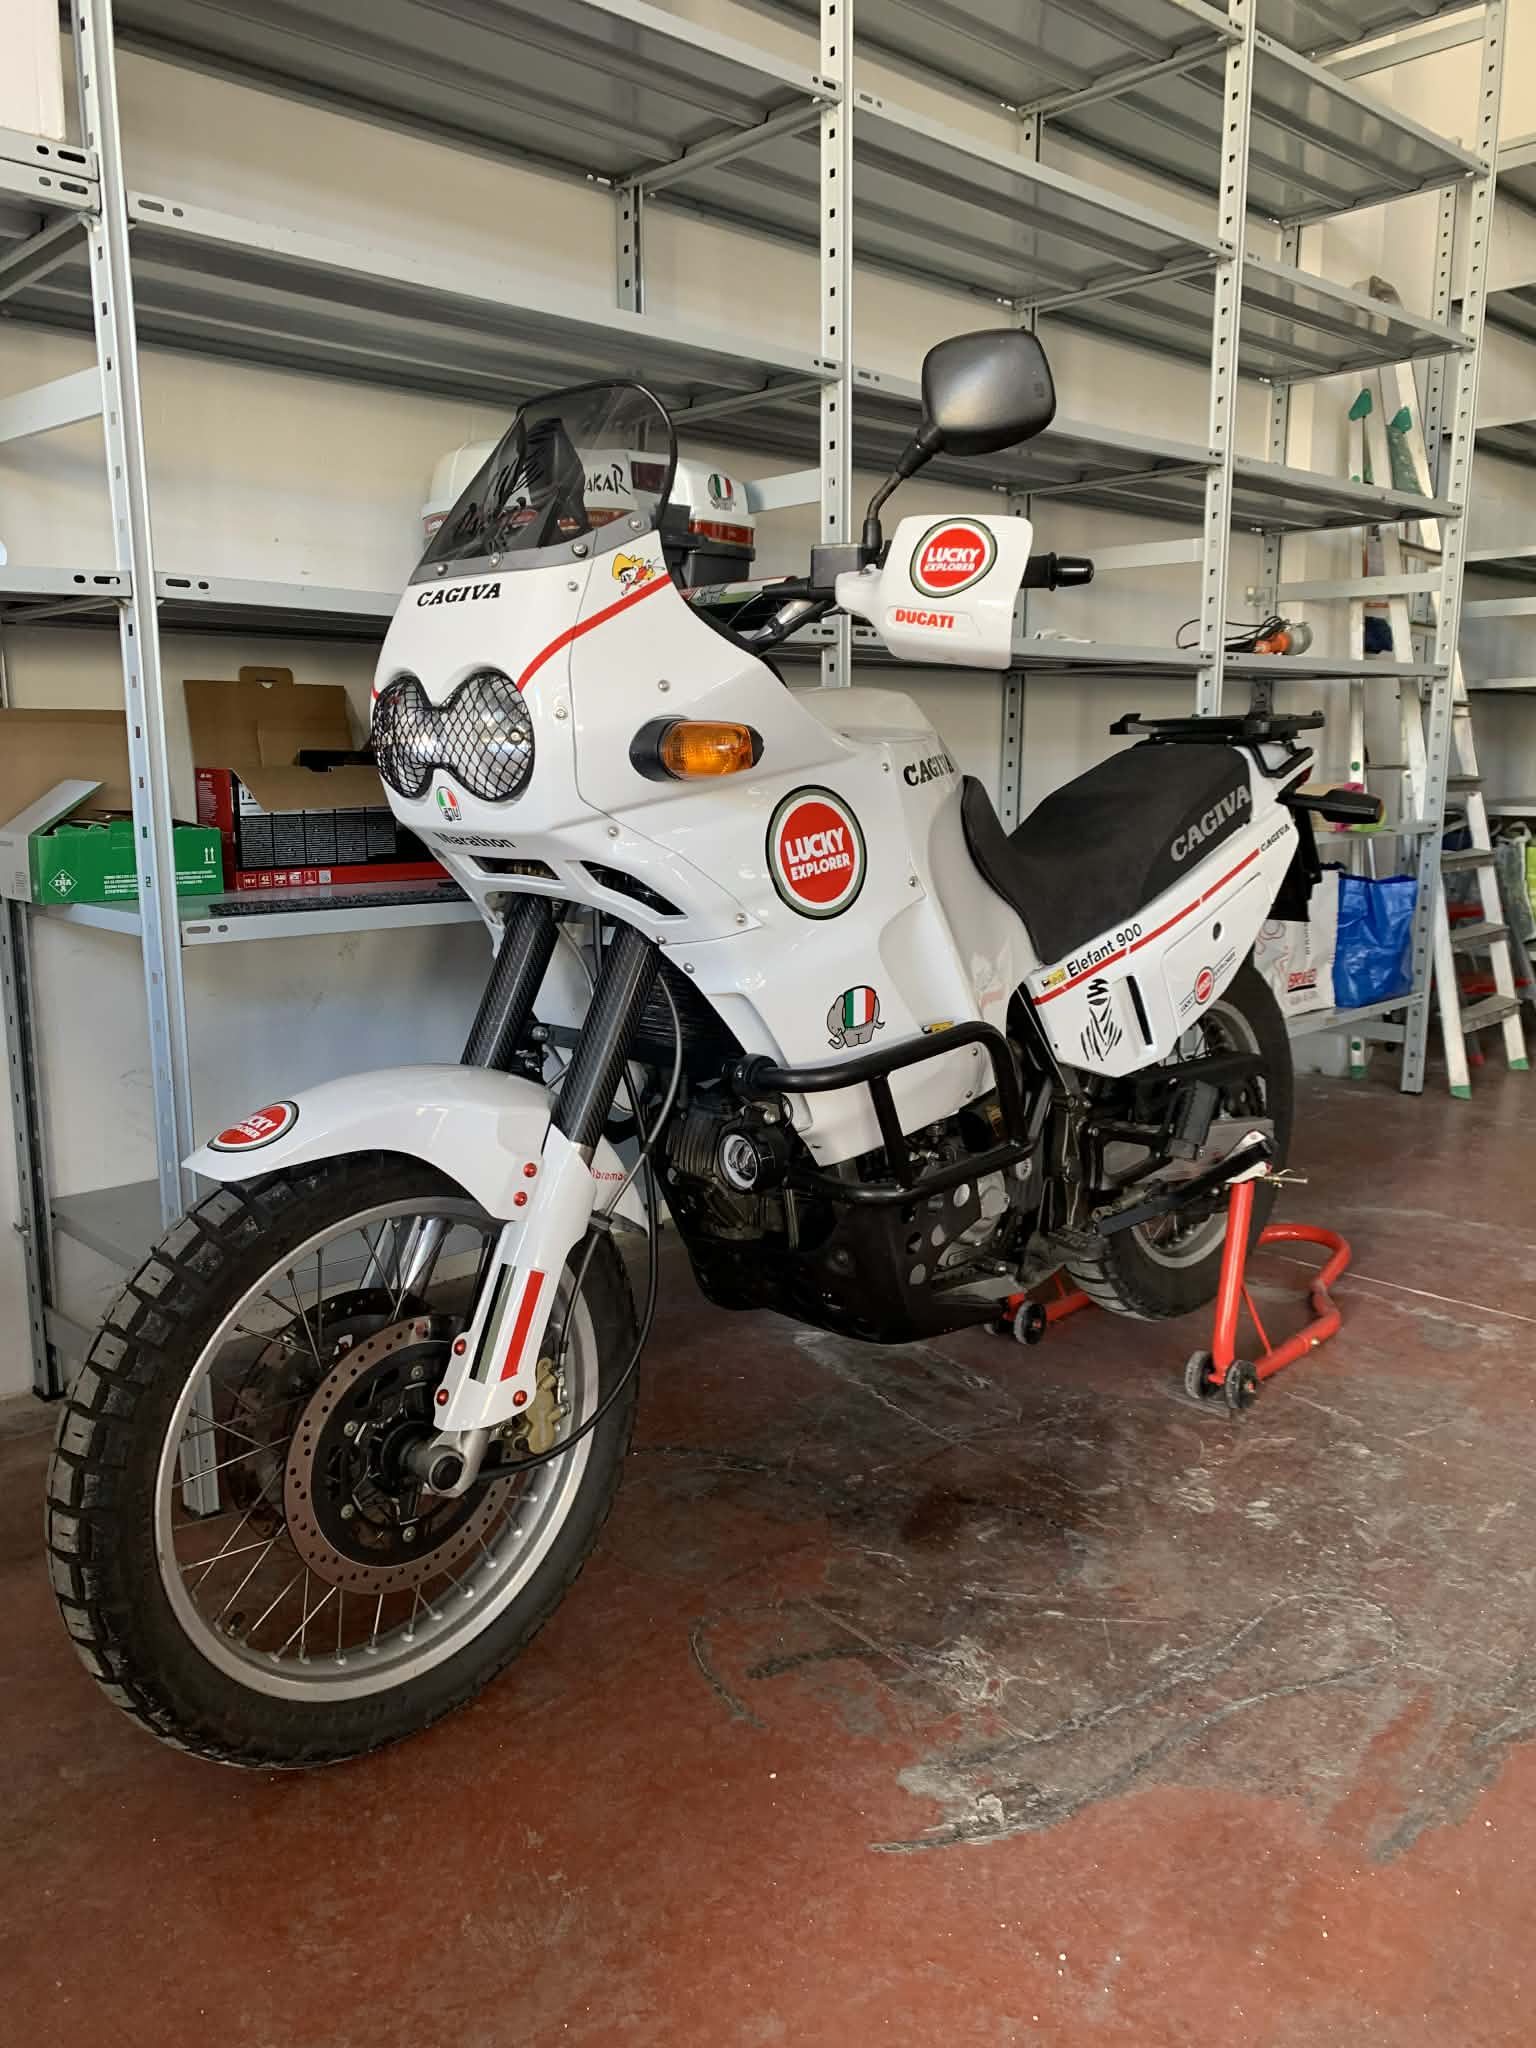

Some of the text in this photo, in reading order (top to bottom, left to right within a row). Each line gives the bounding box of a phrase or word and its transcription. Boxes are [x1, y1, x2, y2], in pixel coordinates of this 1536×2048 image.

[585, 463, 631, 495] AKAR
[923, 562, 976, 572] EXPLORER
[927, 547, 981, 562] LUCKY
[417, 583, 501, 607] CAGIVA
[895, 608, 955, 628] DUCATI
[1170, 784, 1251, 861] CAGIVA
[432, 831, 517, 849] Marathon
[785, 827, 845, 865] LUCKY
[1259, 823, 1290, 852] CAGIVA
[791, 852, 850, 881] EXPLORER
[1066, 940, 1115, 978] Elefant
[1116, 923, 1142, 947] 900
